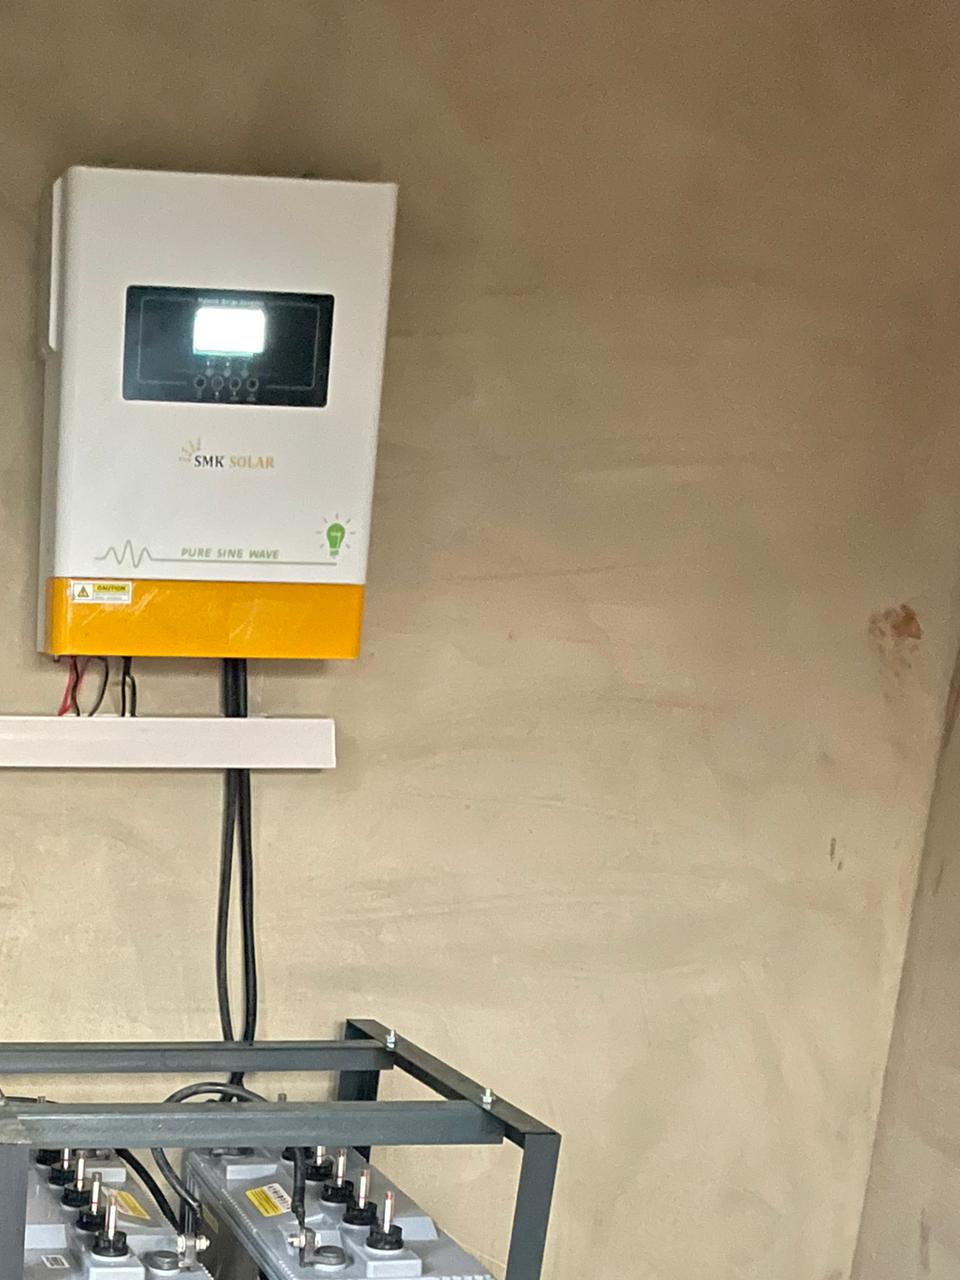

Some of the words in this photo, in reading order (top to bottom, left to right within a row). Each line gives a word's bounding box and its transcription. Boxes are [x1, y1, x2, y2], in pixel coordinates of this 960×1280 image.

[194, 455, 224, 468] SMK
[229, 455, 274, 469] SOLAR
[181, 547, 212, 558] PURE
[217, 548, 243, 559] SINE
[249, 549, 280, 560] WAVE
